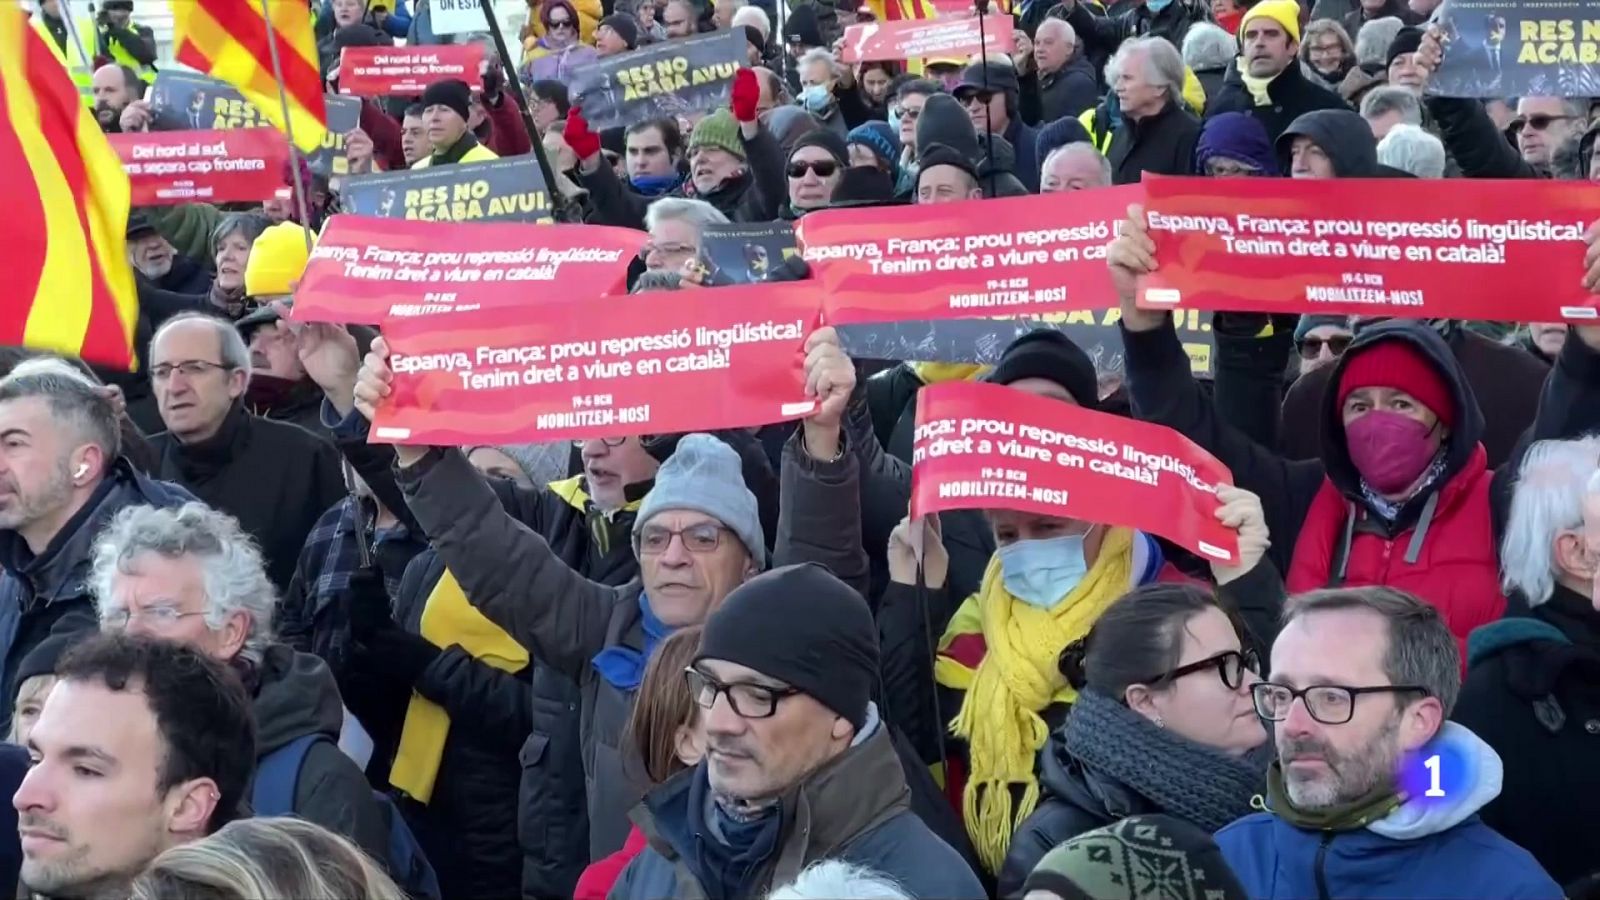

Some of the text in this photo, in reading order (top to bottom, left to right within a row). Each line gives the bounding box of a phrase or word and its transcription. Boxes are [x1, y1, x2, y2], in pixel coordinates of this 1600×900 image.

[1519, 19, 1600, 42] RES N
[1517, 42, 1600, 64] ACAB
[656, 56, 689, 77] NO
[213, 96, 255, 118] RES
[213, 157, 265, 172] frontera
[405, 179, 490, 208] RES NO
[488, 191, 553, 217] AVUI.
[1147, 211, 1234, 236] Espanya,
[1237, 214, 1310, 237] França:
[1314, 220, 1362, 237] prou
[1367, 218, 1463, 240] repressió
[1466, 219, 1585, 243] lingüística!
[803, 241, 883, 262] spanya,
[887, 237, 960, 256] França:
[964, 233, 1012, 252] prou
[1017, 221, 1109, 246] repressió
[1221, 235, 1506, 263] Tenim dret a viure en català!
[363, 245, 421, 265] França:
[424, 251, 463, 267] prou
[463, 248, 534, 266] repressió
[868, 256, 932, 274] Tenim
[935, 253, 978, 271] dret
[981, 255, 995, 268] a
[999, 249, 1048, 266] viure
[1053, 246, 1078, 262] en
[344, 262, 392, 281] Tenim
[394, 266, 428, 281] dret
[429, 269, 440, 281] a
[444, 266, 481, 282] viure
[483, 268, 503, 281] en
[950, 286, 1067, 308] MOBILITZEM-NOS!
[390, 319, 803, 374] Espanya, França: prou repressió lingüística!
[459, 349, 730, 390] Tenim dret a viure en català!
[536, 404, 650, 430] MOBILITZEM-NOS!
[960, 417, 1014, 436] prou
[1018, 424, 1118, 457] repressió
[929, 437, 974, 457] dret
[977, 439, 992, 454] a
[997, 439, 1052, 462] viure
[1057, 451, 1085, 469] en
[1089, 458, 1159, 487] català!
[939, 481, 1069, 506] MOBILITZEM-NOS!
